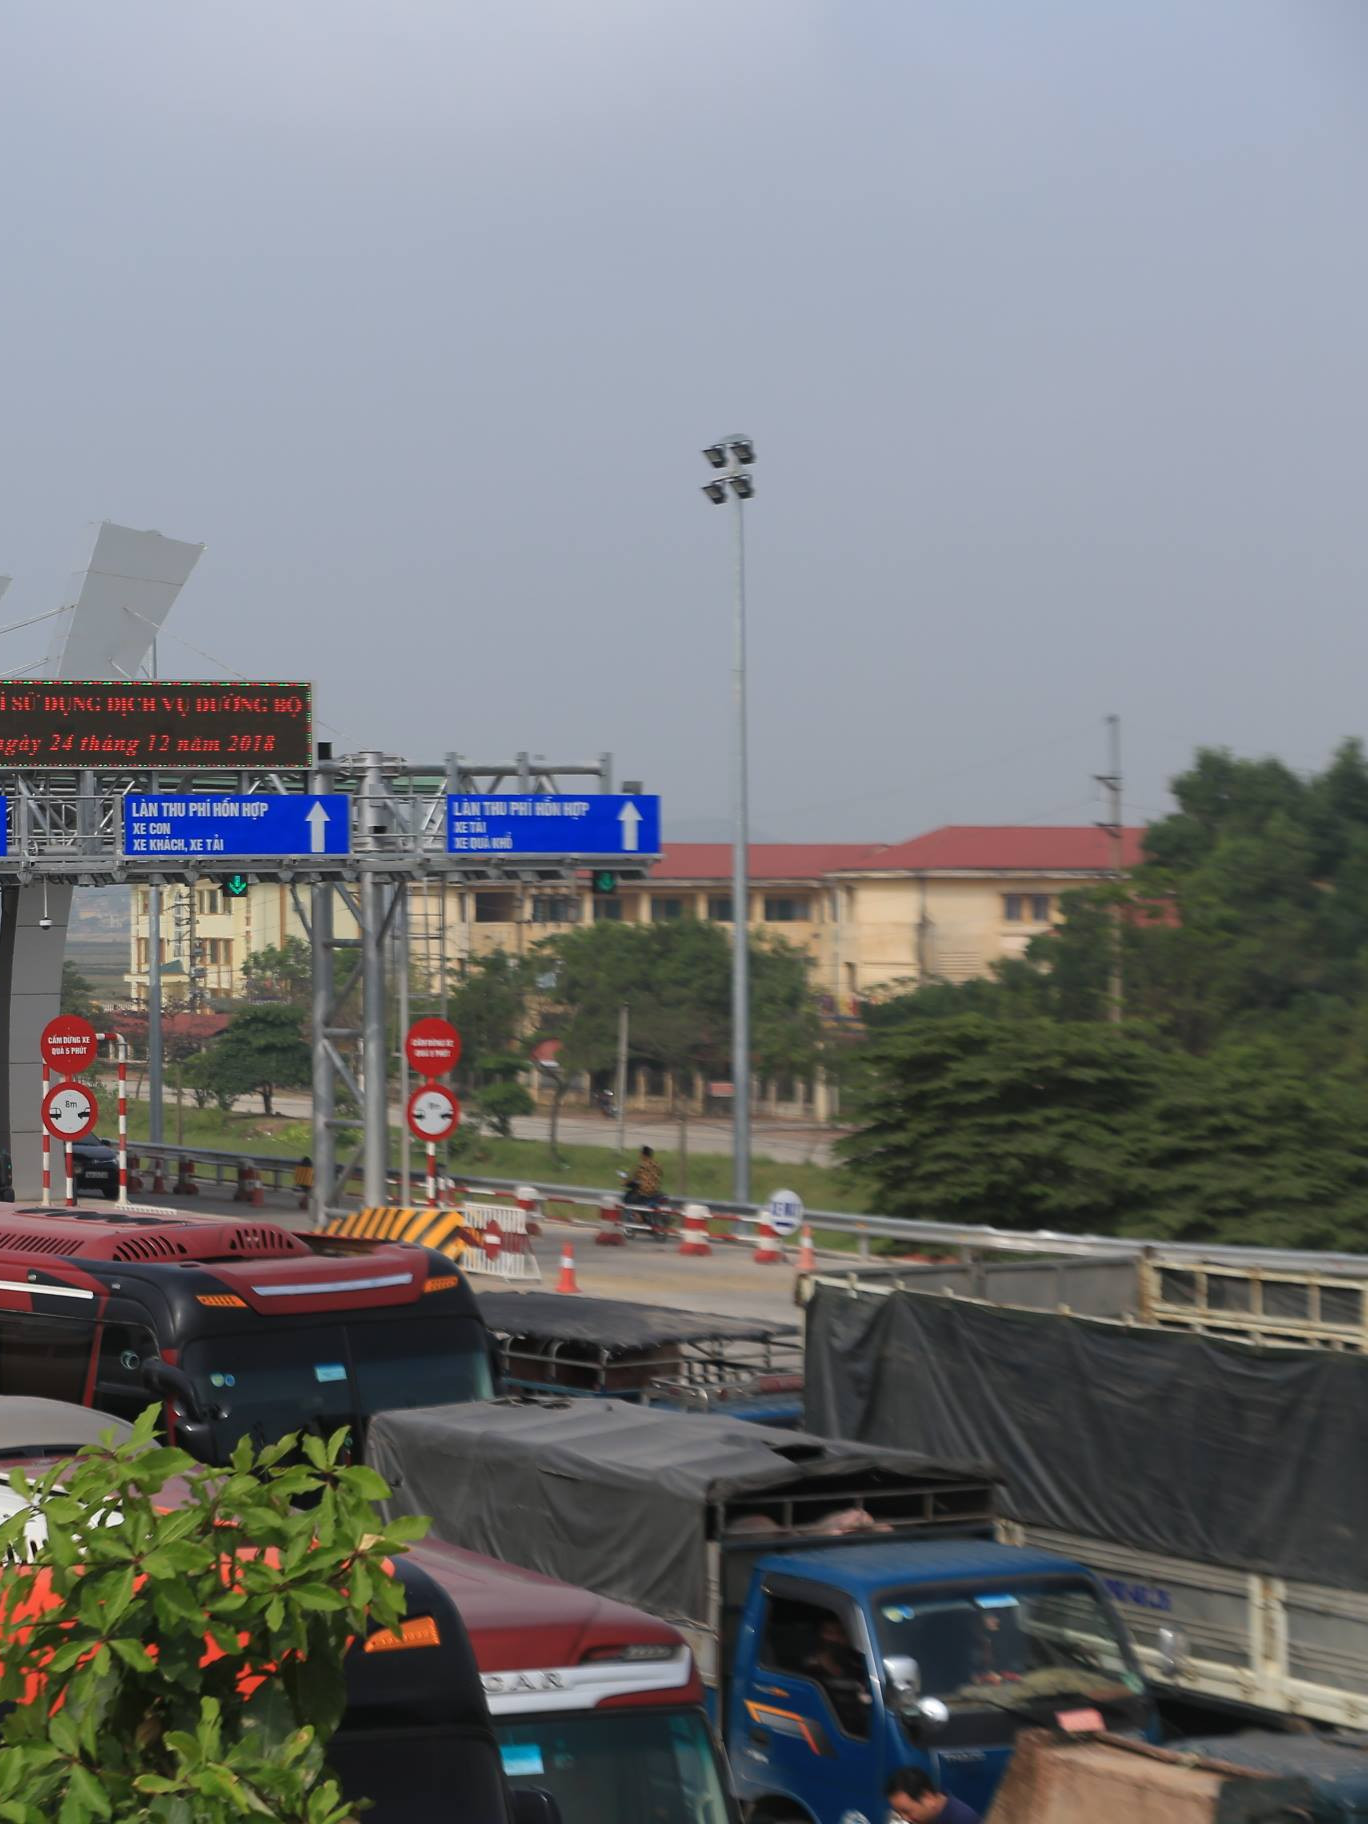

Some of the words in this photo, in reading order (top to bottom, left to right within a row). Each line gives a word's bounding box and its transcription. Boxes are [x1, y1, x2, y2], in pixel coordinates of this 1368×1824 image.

[44, 696, 101, 717] DỤNG
[106, 696, 156, 717] DỊCH
[48, 734, 75, 751] 24
[80, 734, 141, 756] tháng
[147, 734, 172, 751] 12
[177, 735, 221, 752] năm
[227, 734, 277, 752] 2018
[132, 799, 158, 817] LÀN
[162, 802, 186, 817] THU
[189, 799, 211, 817] PHÍ
[242, 802, 269, 820] HỢP
[453, 798, 481, 816] LÀN
[482, 802, 508, 816] THU
[509, 798, 532, 816] PHÍ
[133, 822, 147, 835] XE
[149, 822, 171, 835] CON
[454, 821, 469, 833] XE
[133, 839, 147, 851] XE
[189, 839, 203, 851] XE
[206, 834, 224, 851] TẢI
[454, 837, 469, 849] XE
[82, 1036, 91, 1044] XE
